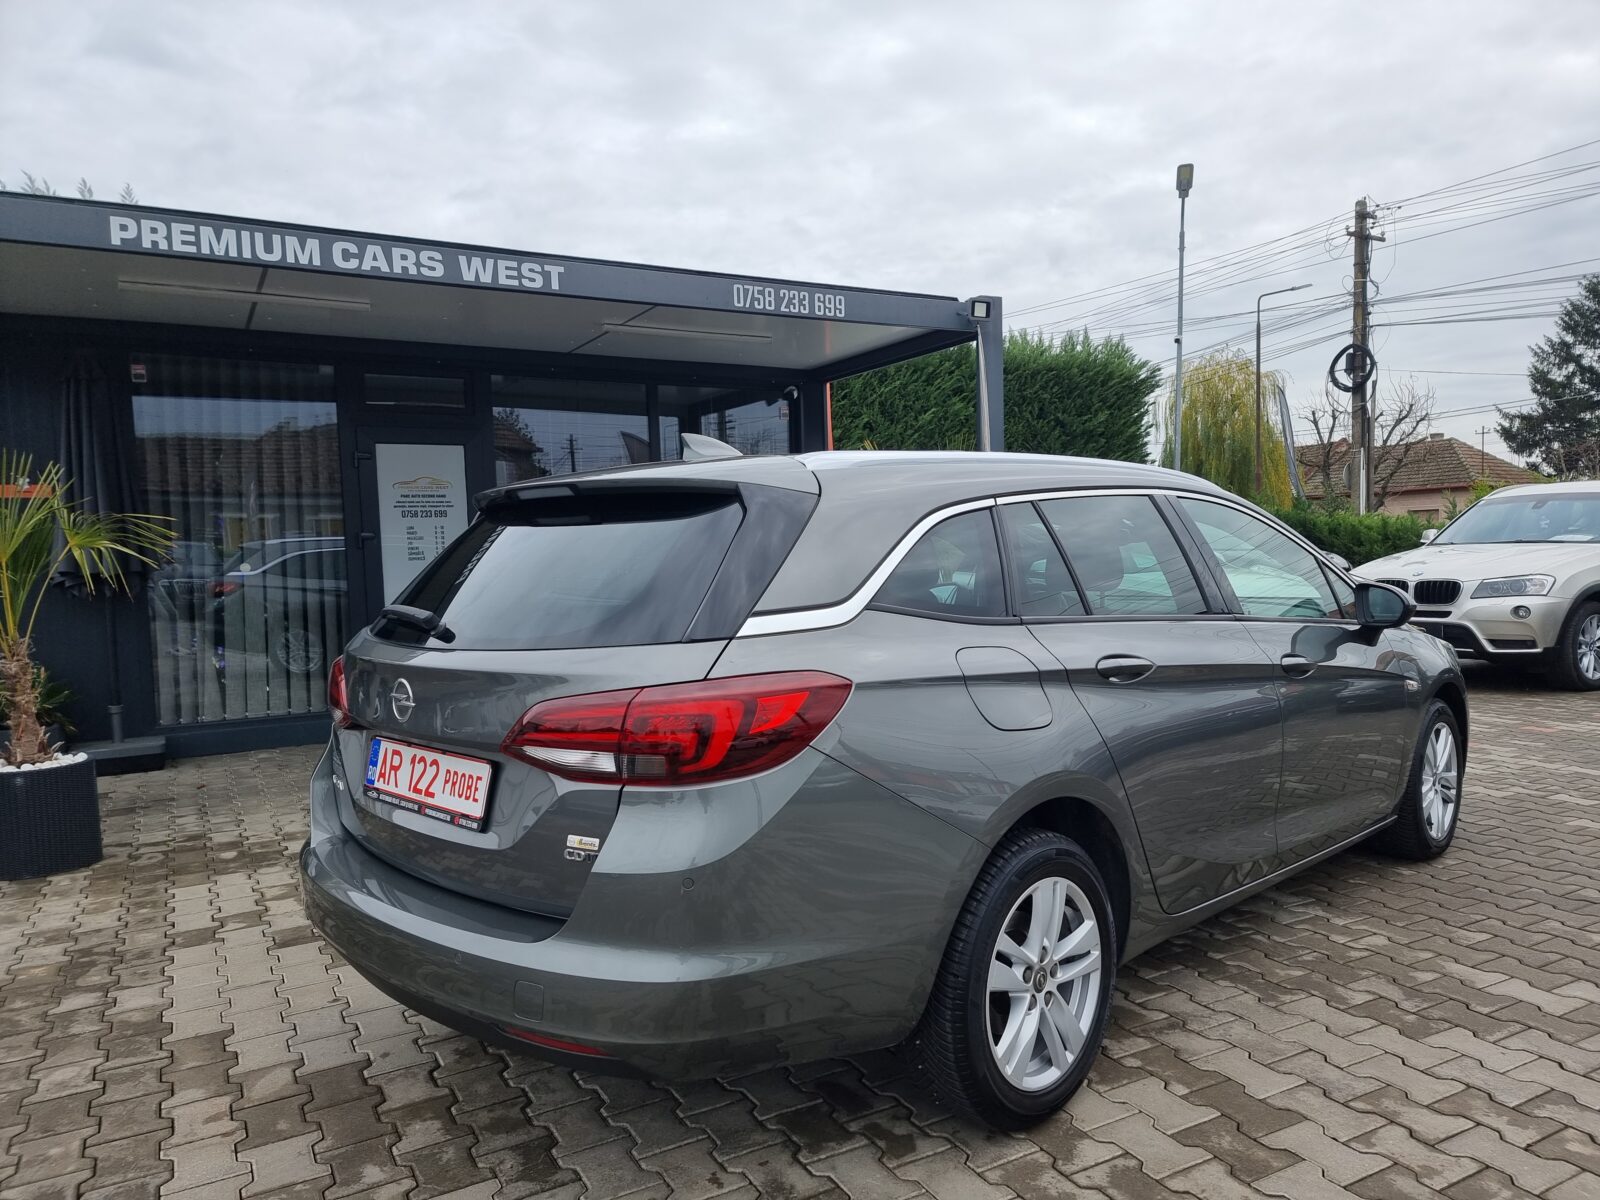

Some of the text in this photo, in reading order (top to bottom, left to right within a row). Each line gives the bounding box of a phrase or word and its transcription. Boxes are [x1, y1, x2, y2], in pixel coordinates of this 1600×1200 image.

[109, 215, 565, 290] PREMIUM CARS WEST
[733, 284, 845, 317] 0758 233 699
[401, 509, 448, 519] 0758 233 699
[367, 765, 377, 781] RO
[376, 746, 404, 789] AR
[408, 753, 440, 799] 122
[441, 768, 483, 803] PROBE
